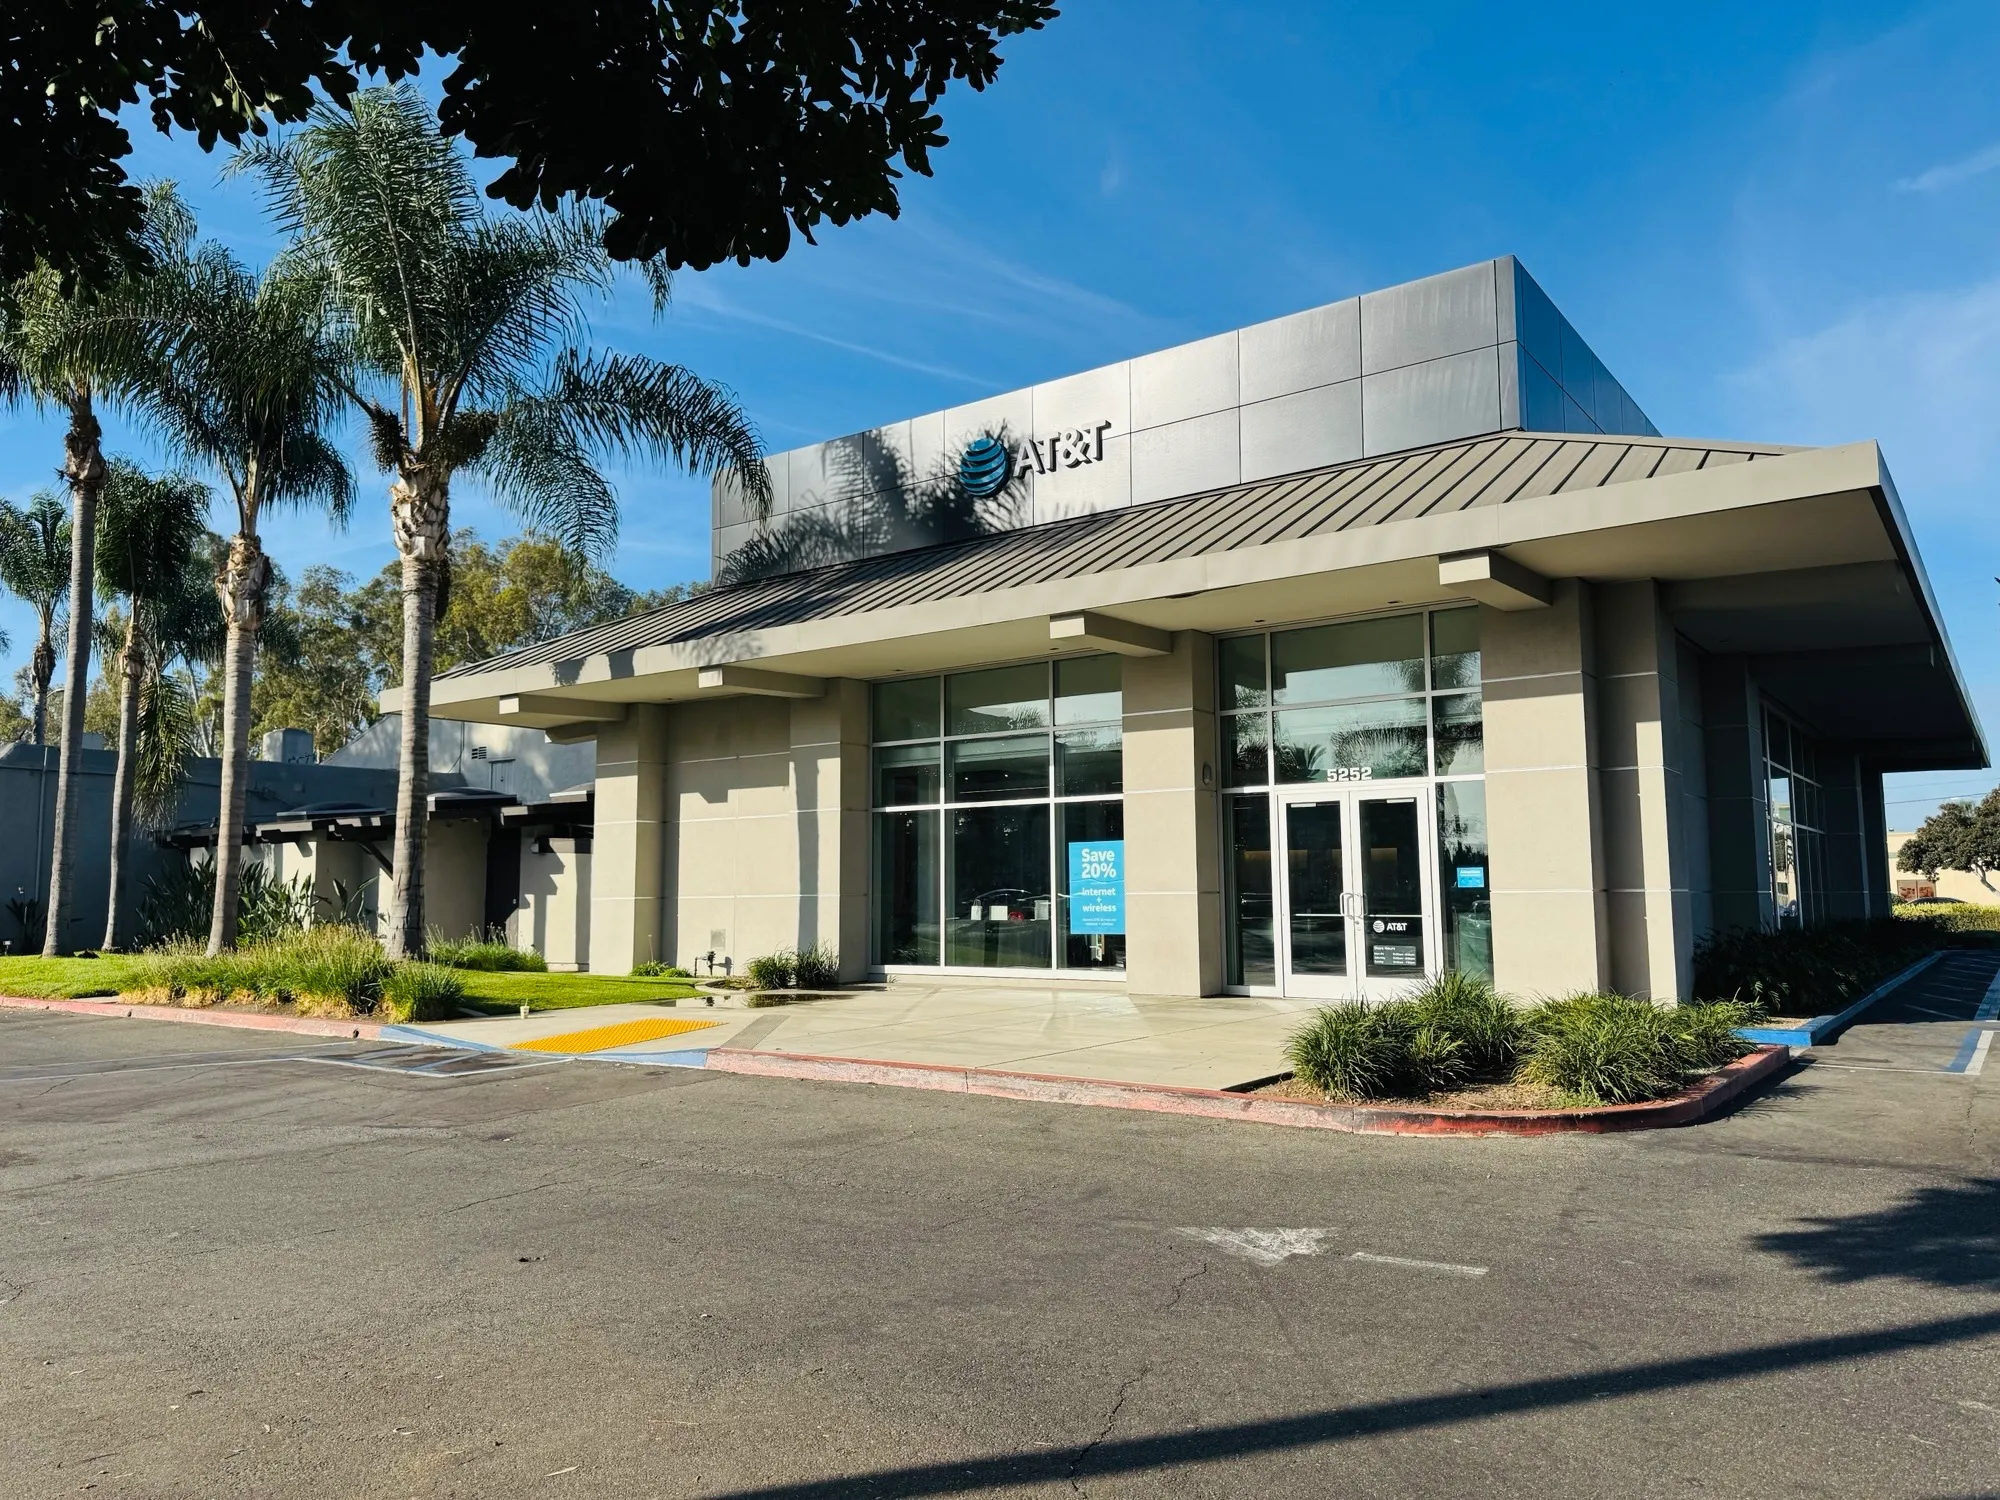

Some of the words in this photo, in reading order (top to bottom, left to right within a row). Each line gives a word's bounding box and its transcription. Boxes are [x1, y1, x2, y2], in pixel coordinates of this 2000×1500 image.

[1013, 419, 1112, 479] AT&T
[1326, 766, 1373, 782] 5252
[1081, 848, 1115, 862] Save
[1081, 863, 1117, 879] 20%
[1082, 887, 1116, 896] internet
[1082, 903, 1117, 912] wireless
[1386, 922, 1407, 931] AT&T
